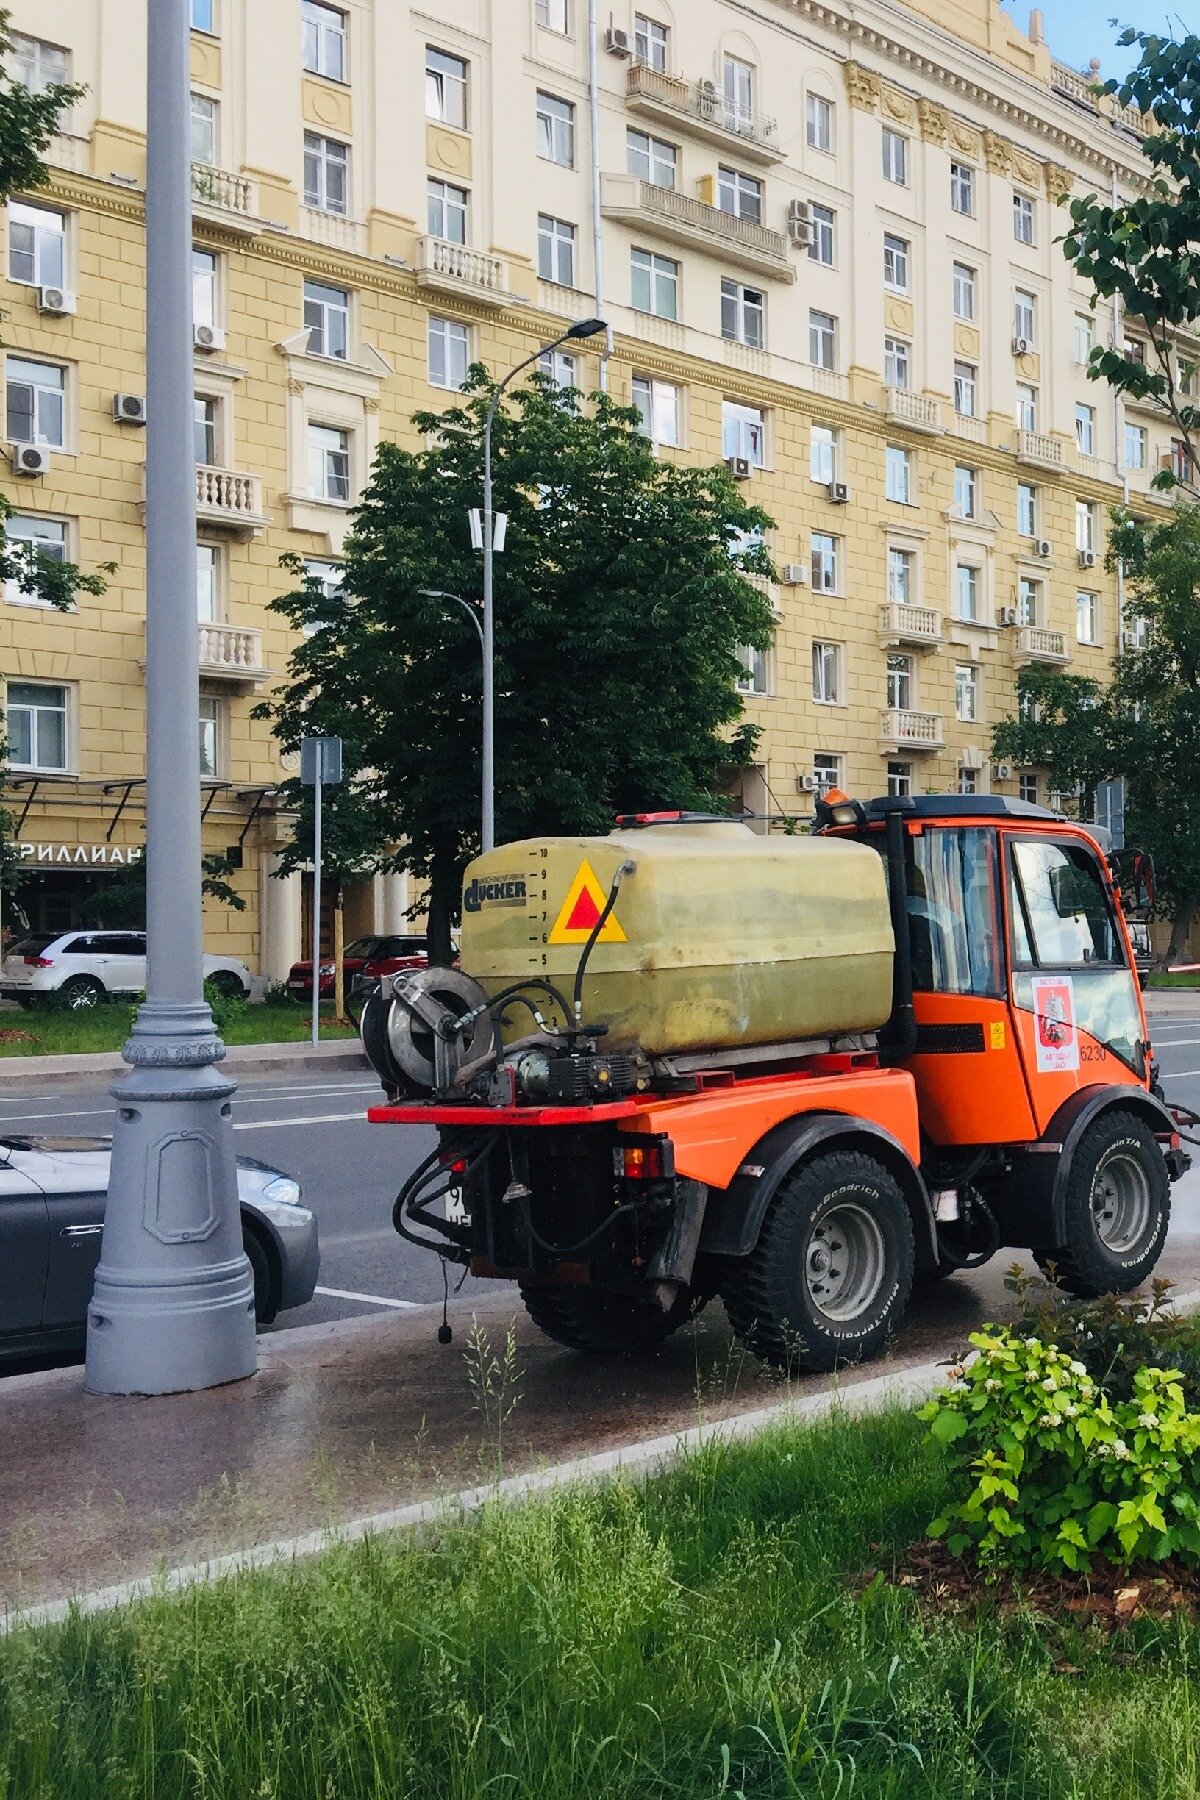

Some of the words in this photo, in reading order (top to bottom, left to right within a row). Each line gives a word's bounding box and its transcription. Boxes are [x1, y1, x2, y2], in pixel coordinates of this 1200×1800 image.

[540, 848, 548, 858] 10
[541, 869, 547, 880] 9
[541, 889, 547, 901] 8
[541, 911, 547, 922] 7
[542, 932, 548, 944] 6
[541, 953, 547, 966] 5
[548, 995, 554, 1006] 3
[552, 1016, 558, 1027] 2
[1080, 1045, 1107, 1062] 6230
